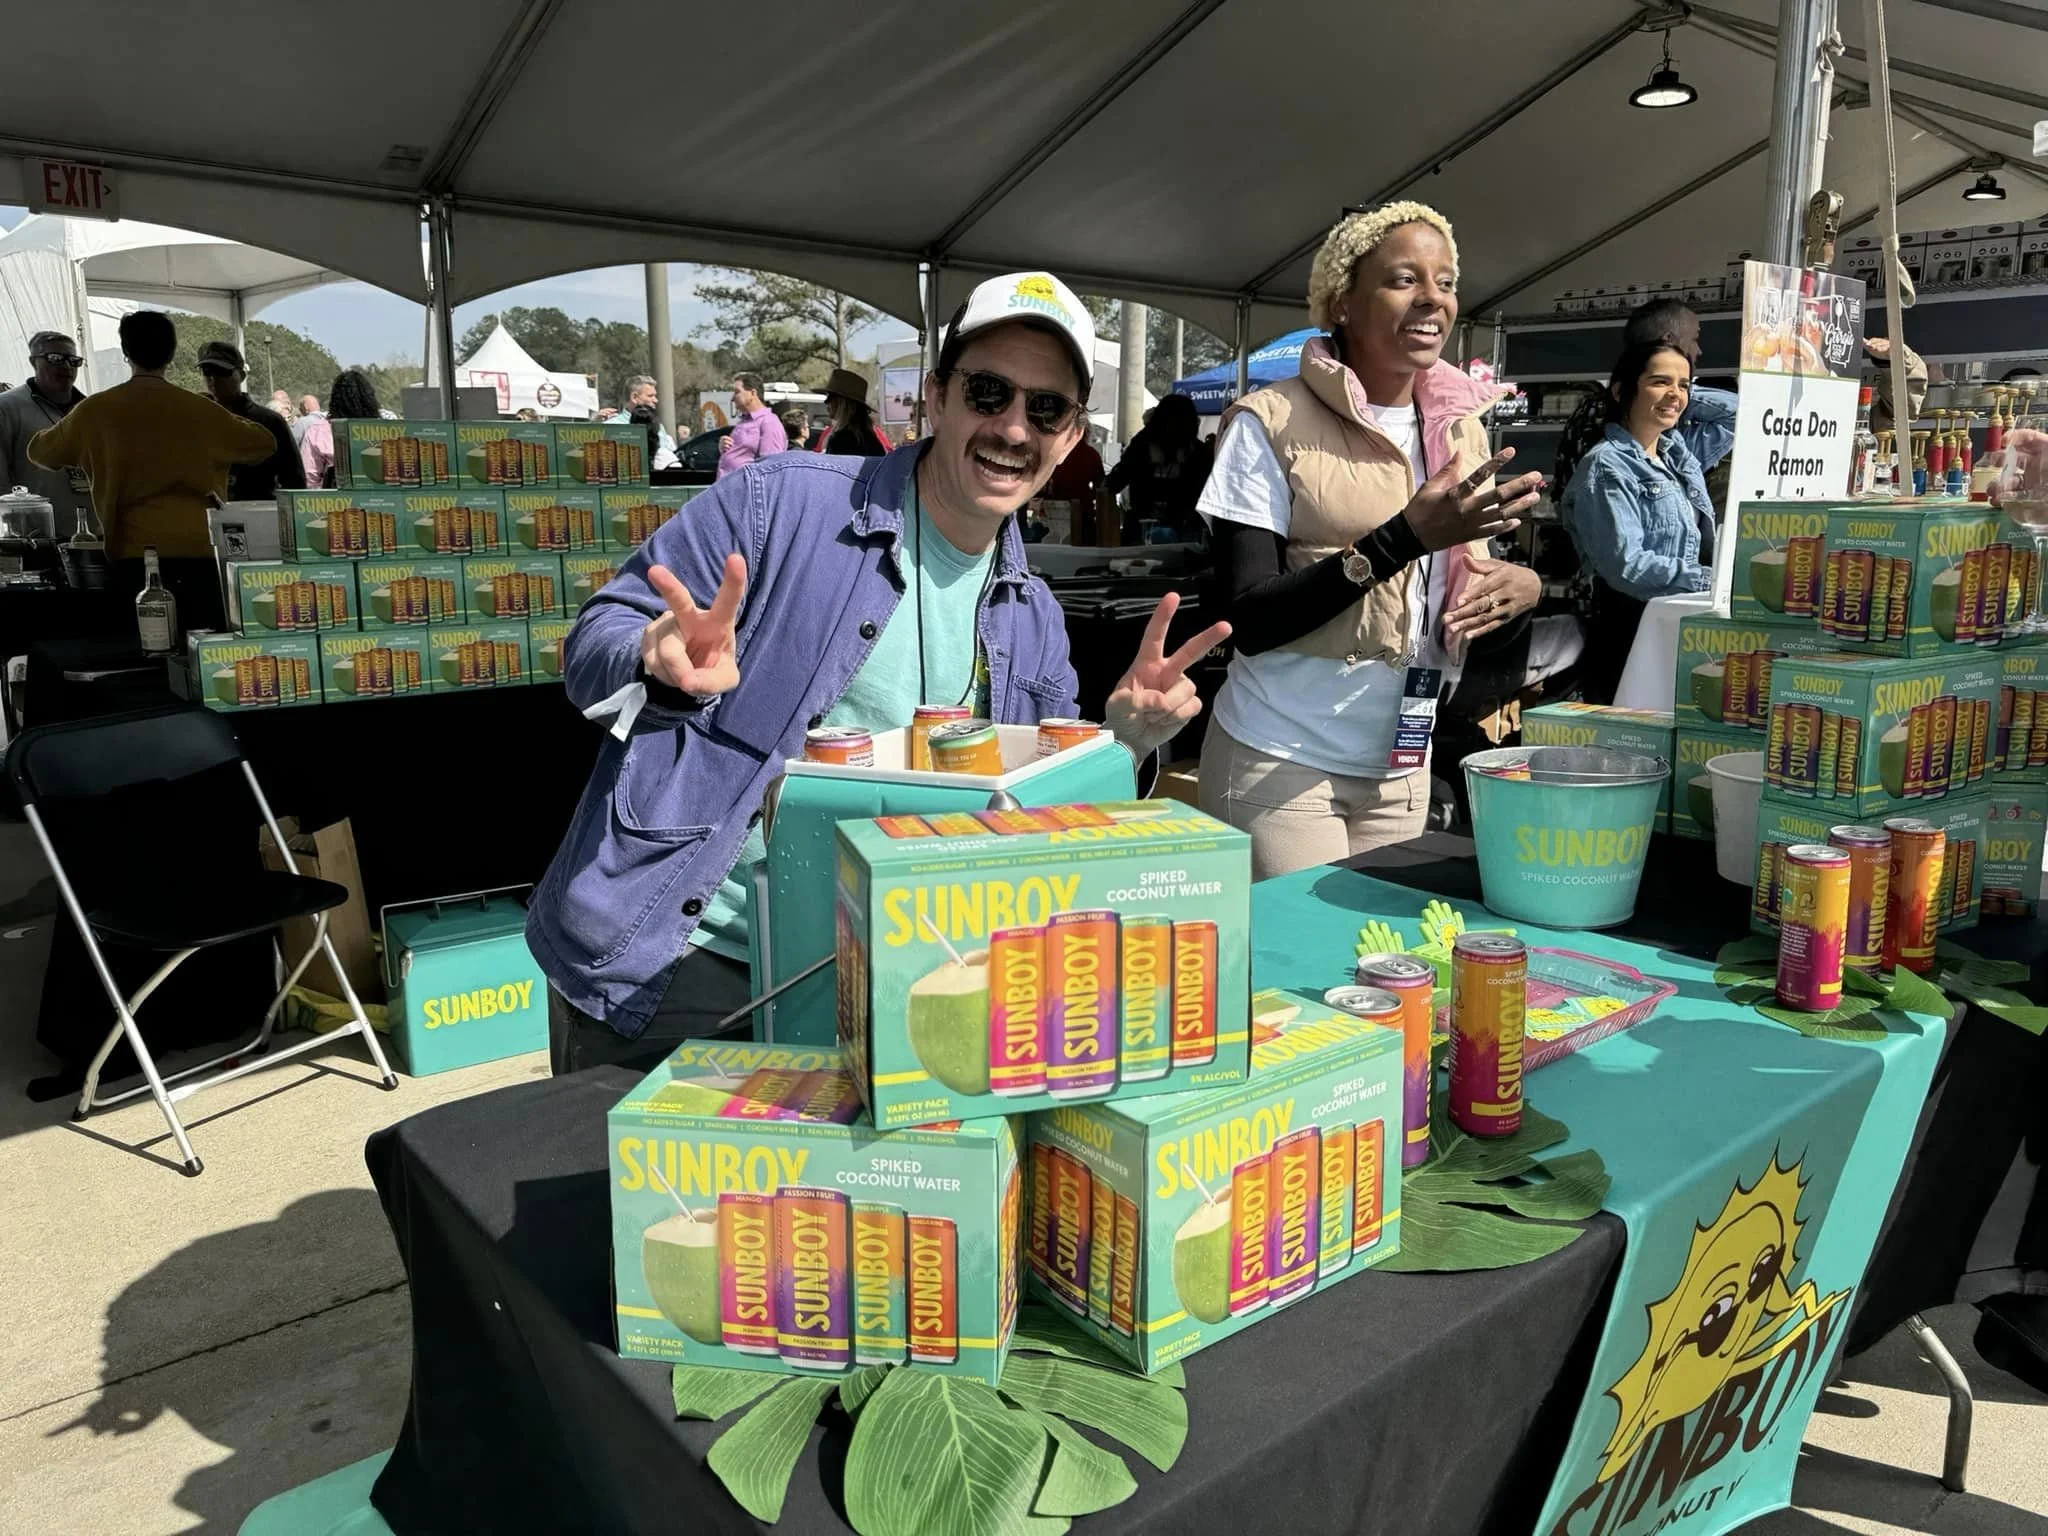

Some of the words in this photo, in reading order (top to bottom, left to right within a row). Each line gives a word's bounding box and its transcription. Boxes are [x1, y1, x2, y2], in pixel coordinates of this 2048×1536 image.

[44, 163, 102, 208] EXIT
[352, 425, 407, 441] SUNBOY
[459, 427, 509, 443] SUNBOY
[559, 428, 606, 443] SUNBOY
[1762, 409, 1801, 436] Casa
[1808, 412, 1837, 437] Don
[1768, 450, 1824, 476] Ramon
[296, 497, 352, 513] SUNBOY
[405, 496, 457, 512] SUNBOY
[509, 496, 556, 512] SUNBOY
[605, 495, 648, 509] SUNBOY
[1848, 522, 1896, 538] SUNBOY
[1926, 521, 2000, 557] SUNBOY
[242, 570, 301, 588] SUNBOY
[362, 566, 415, 583] SUNBOY
[467, 561, 516, 578] SUNBOY
[566, 560, 611, 574] SUNBOY
[1792, 545, 1814, 600] SUNBOY
[1824, 561, 1841, 616] SUNBOY
[1844, 559, 1866, 622] SUNBOY
[1872, 562, 1891, 622] SUNBOY
[1962, 559, 1982, 623] SUNBOY
[1984, 556, 2005, 624] SUNBOY
[202, 646, 262, 664] SUNBOY
[324, 639, 378, 656] SUNBOY
[431, 631, 481, 648] SUNBOY
[532, 625, 574, 641] SUNBO
[1683, 627, 1771, 651] SUNBOY
[261, 662, 272, 696] SUNBOY
[1731, 661, 1748, 711] SUNBOY
[1792, 675, 1844, 695] SUNBOY
[1875, 676, 1945, 716] SUNBOY
[1524, 722, 1597, 746] SUNBOY
[1769, 714, 1785, 773] SUNBOY
[1790, 711, 1812, 777] SUNBOY
[1819, 719, 1839, 778] SUNBOY
[1840, 725, 1858, 780] SUNBOY
[1910, 714, 1929, 778] SUNBOY
[1930, 708, 1950, 777] SUNBOY
[1952, 711, 1972, 771] SUNBOY
[1516, 824, 1650, 868] SUNBOY
[1779, 816, 1827, 834] SUNBOY
[1107, 884, 1177, 902] COCONUT
[1179, 881, 1222, 897] WATER
[1140, 870, 1186, 884] SPIKED
[1521, 872, 1560, 884] SPIKED
[1563, 872, 1617, 886] COCONUT
[1758, 850, 1774, 906] SUNBOY
[884, 873, 1081, 946] SUNBOY
[1056, 915, 1086, 923] PASSION
[1867, 866, 1888, 952] SUNBOY
[423, 979, 534, 1030] SUNBOY
[1006, 947, 1037, 1060] SUNBOY
[1064, 934, 1098, 1059] SUNBOY
[1126, 936, 1156, 1049] SUNBOY
[1177, 940, 1204, 1035] SUNBOY
[1497, 991, 1525, 1099] SUNBOY
[886, 1101, 923, 1114] VARIETY
[925, 1098, 949, 1109] PACK
[1312, 1094, 1359, 1119] COCONUT
[1359, 1082, 1387, 1101] WATER
[1333, 1078, 1364, 1098] SPIKED
[1056, 1107, 1113, 1153] SUNBOY
[1156, 1098, 1295, 1198] SUNBOY
[618, 1137, 808, 1197] SUNBOY
[871, 1158, 922, 1174] SPIKED
[1066, 1136, 1102, 1162] COCONUT
[1104, 1156, 1128, 1178] WATER
[736, 1195, 762, 1203] MANGO
[784, 1189, 815, 1198] PASSION
[816, 1191, 835, 1200] FRUIT
[836, 1171, 910, 1189] COCONUT
[912, 1176, 961, 1192] WATER
[1322, 1142, 1346, 1243] SUNBOY
[1356, 1136, 1376, 1226] SUNBOY
[1033, 1161, 1048, 1255] SUNBOY
[1057, 1167, 1080, 1279] SUNBOY
[1241, 1173, 1267, 1283] SUNBOY
[1280, 1151, 1307, 1271] SUNBOY
[1092, 1192, 1112, 1295] SUNBOY
[1115, 1210, 1135, 1306] SUNBOY
[733, 1212, 767, 1321] SUNBOY
[792, 1208, 831, 1331] SUNBOY
[856, 1220, 891, 1330] SUNBOY
[913, 1232, 943, 1332] SUNBOY
[626, 1335, 659, 1346] VARIETY
[661, 1339, 684, 1348] PACK
